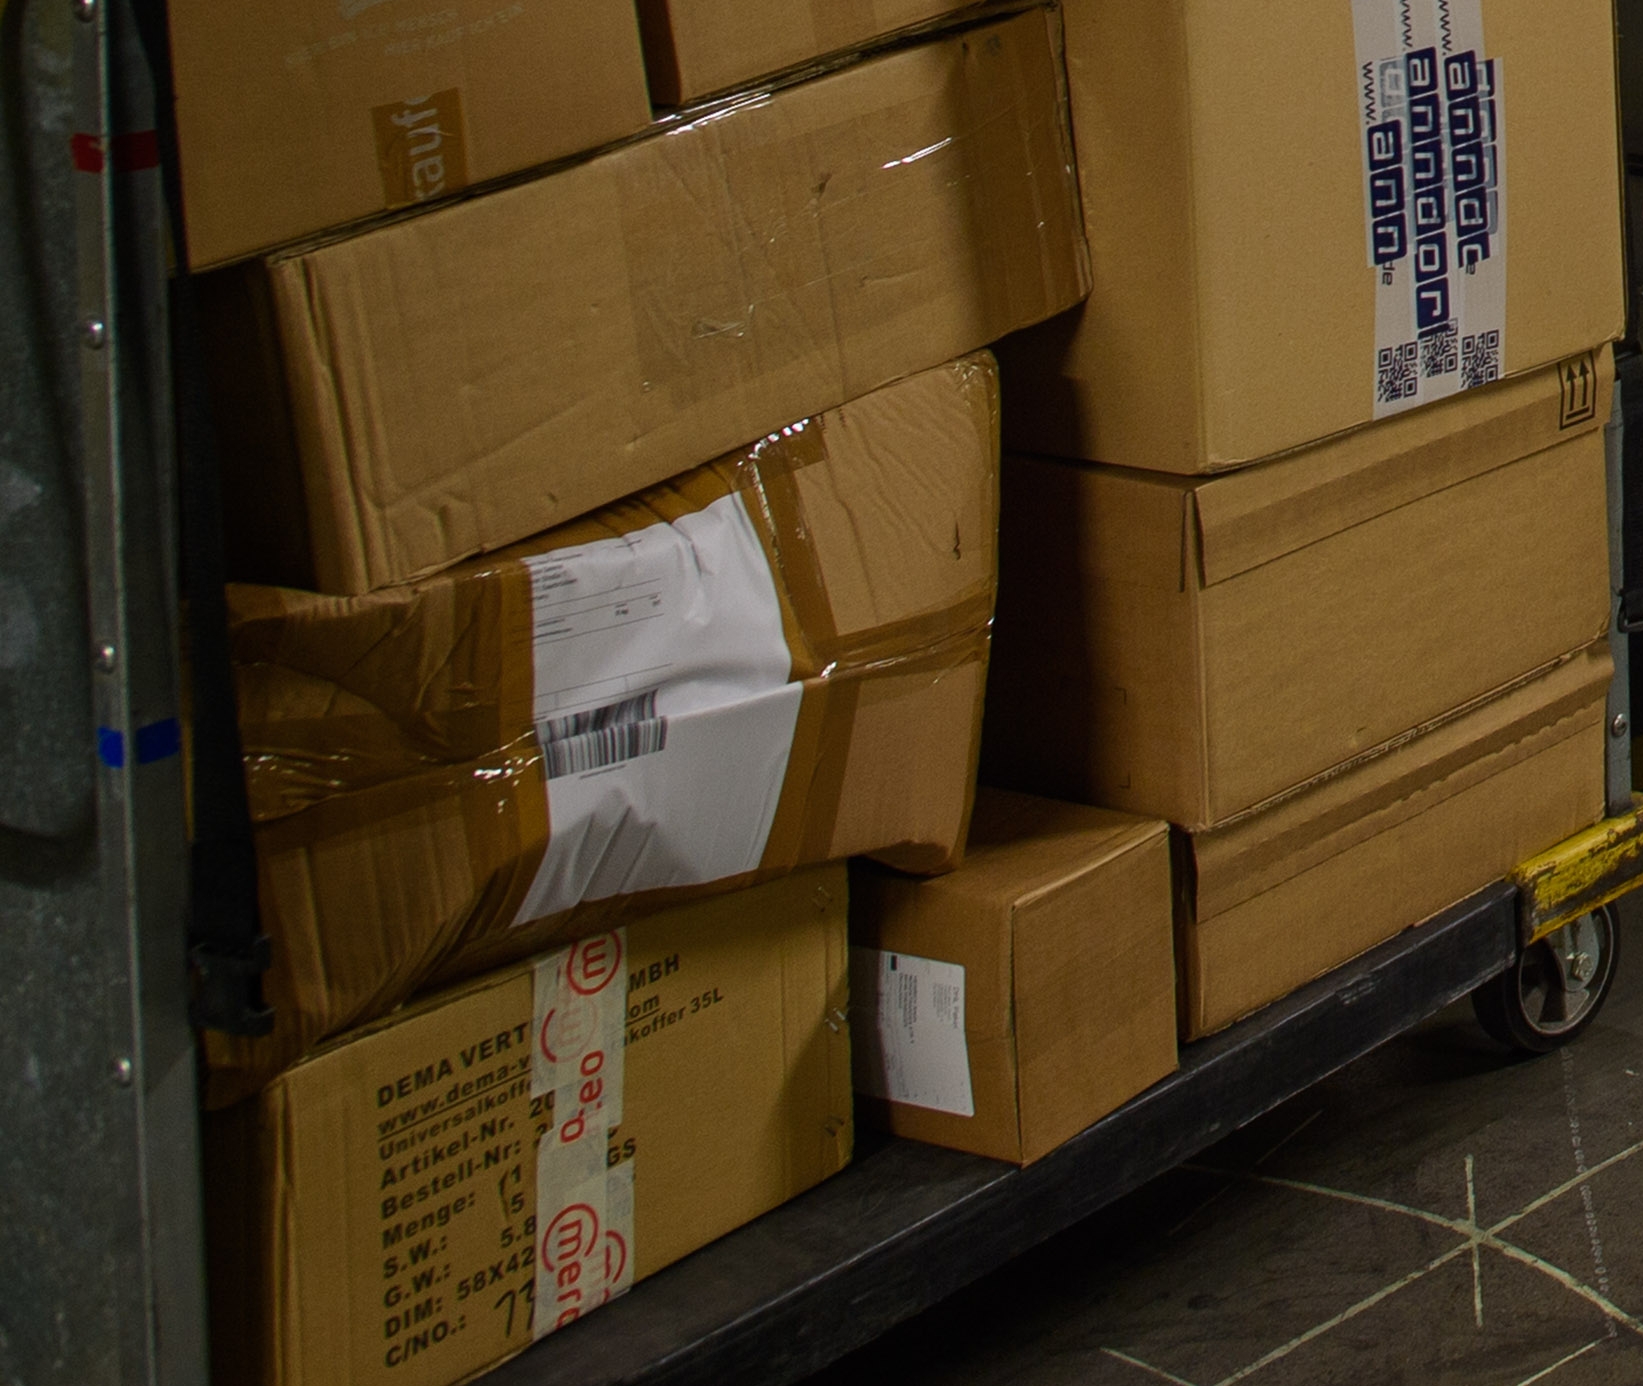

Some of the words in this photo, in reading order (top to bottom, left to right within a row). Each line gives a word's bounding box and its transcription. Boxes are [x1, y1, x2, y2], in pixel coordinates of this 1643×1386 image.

[1362, 62, 1408, 266] www.ann
[377, 1058, 453, 1108] DEMA
[459, 1021, 530, 1068] VERT
[628, 953, 680, 993] MBH
[689, 986, 724, 1016] 35L
[377, 1054, 531, 1137] www.dema-v
[628, 994, 660, 1021] om
[380, 1136, 522, 1221] Bestell-Nr:
[381, 1116, 514, 1191] Artikel-Nr.
[382, 1191, 476, 1251] Menge:
[383, 1234, 448, 1280] S.W.:
[606, 1137, 637, 1165] GS
[383, 1262, 450, 1309] G.W.:
[500, 1214, 537, 1250] 5.8
[384, 1295, 443, 1340] DIM:
[456, 1244, 537, 1302] 58X42
[384, 1314, 467, 1368] C/NO.:
